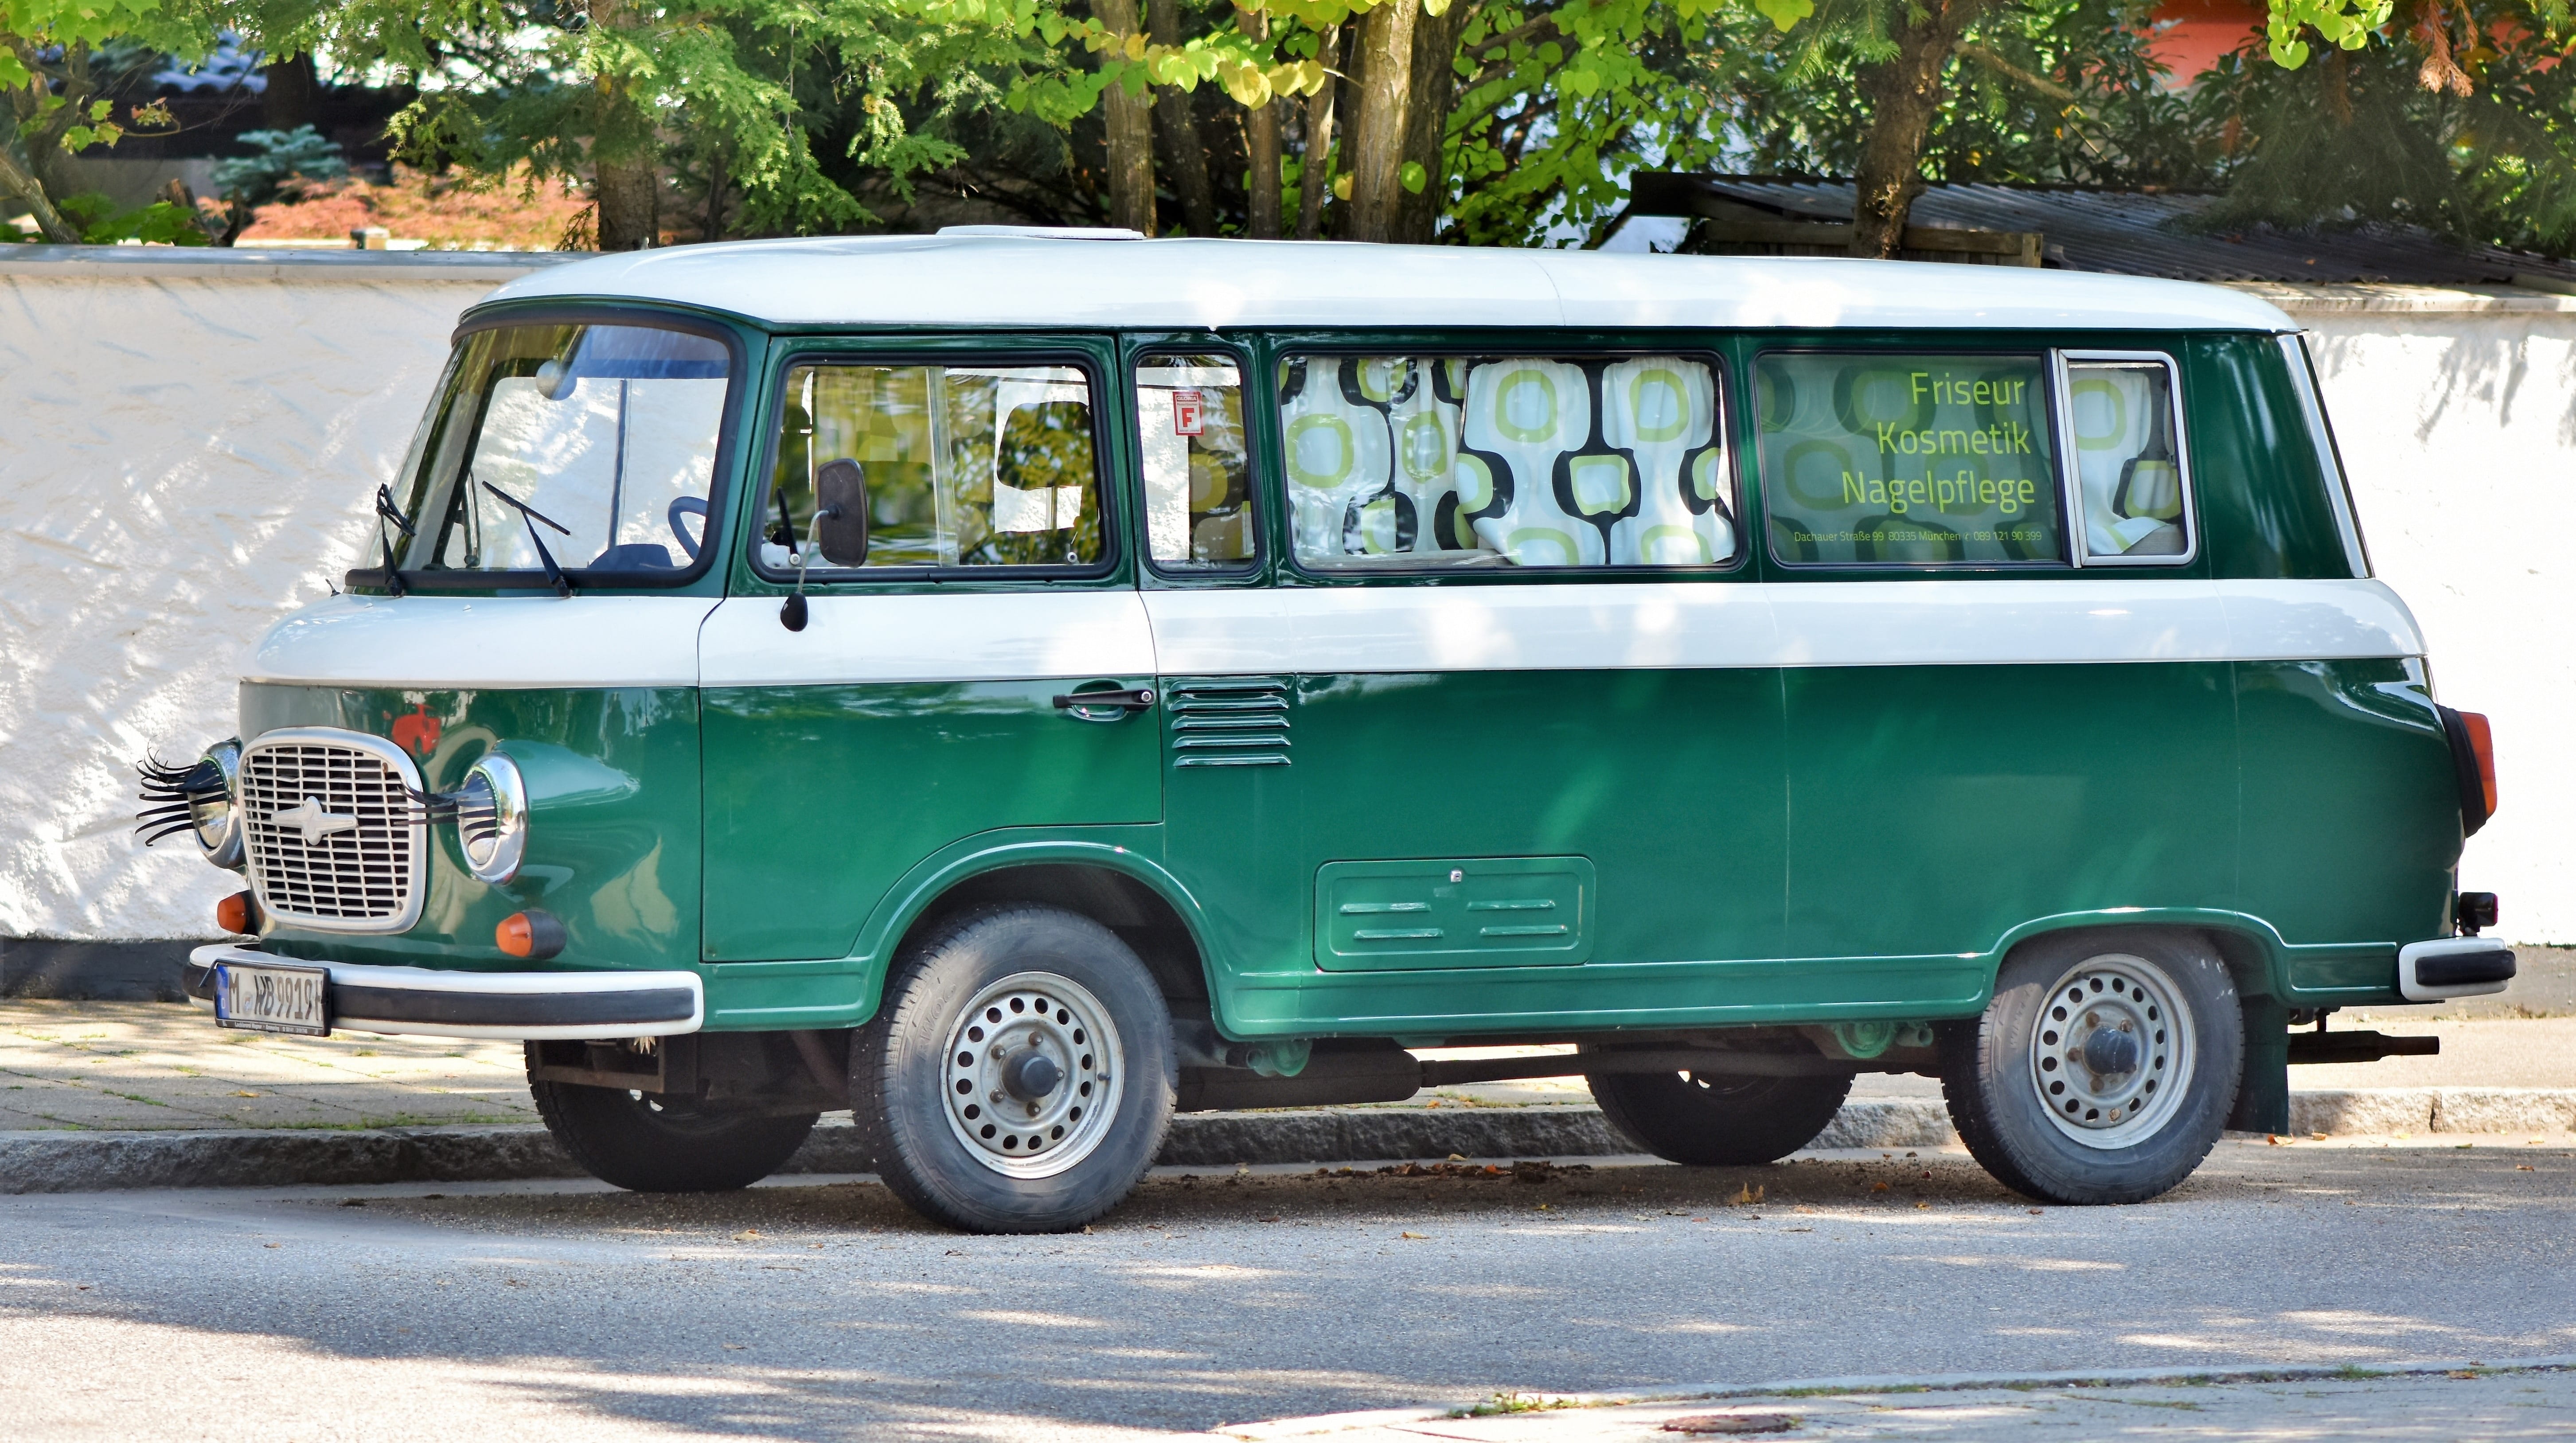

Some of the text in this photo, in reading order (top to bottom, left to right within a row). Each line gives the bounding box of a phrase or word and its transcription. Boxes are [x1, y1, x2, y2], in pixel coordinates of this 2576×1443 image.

[1911, 372, 2025, 405] Friseur
[1182, 408, 1194, 428] F
[1877, 421, 2031, 454] Kosmetik
[1842, 470, 2035, 514] Nagelpflege
[1794, 531, 2042, 542] Dachauer Straße 99 80335 München 089 121 90 399
[228, 972, 240, 1014] M
